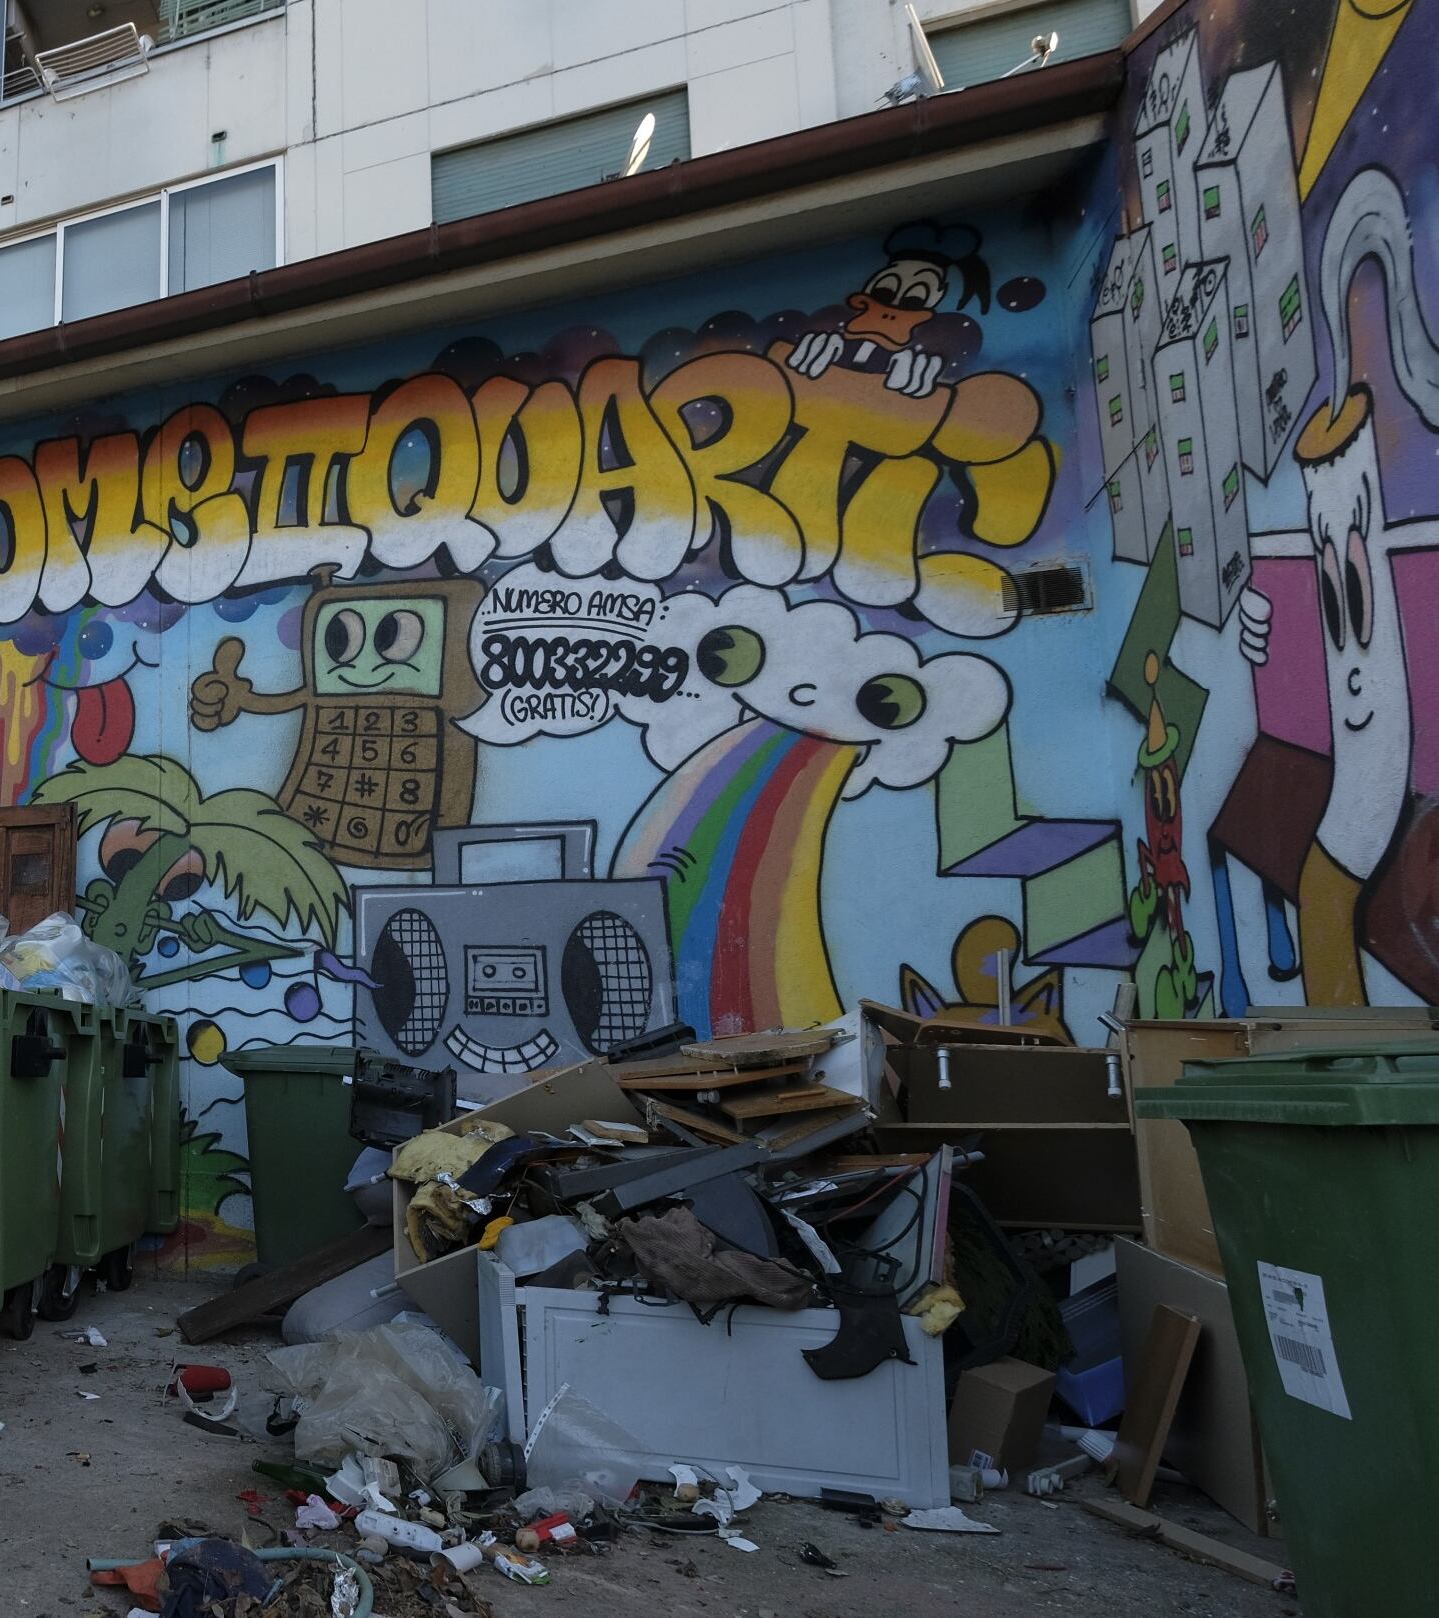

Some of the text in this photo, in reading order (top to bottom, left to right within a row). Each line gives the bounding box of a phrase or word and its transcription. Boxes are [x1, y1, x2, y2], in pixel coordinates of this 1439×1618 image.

[500, 688, 610, 726] (GRATIS!)
[328, 710, 419, 732] 1 2 3
[320, 737, 419, 764] 4 5 6
[317, 769, 421, 804] 7 # 8
[394, 820, 410, 846] 0
